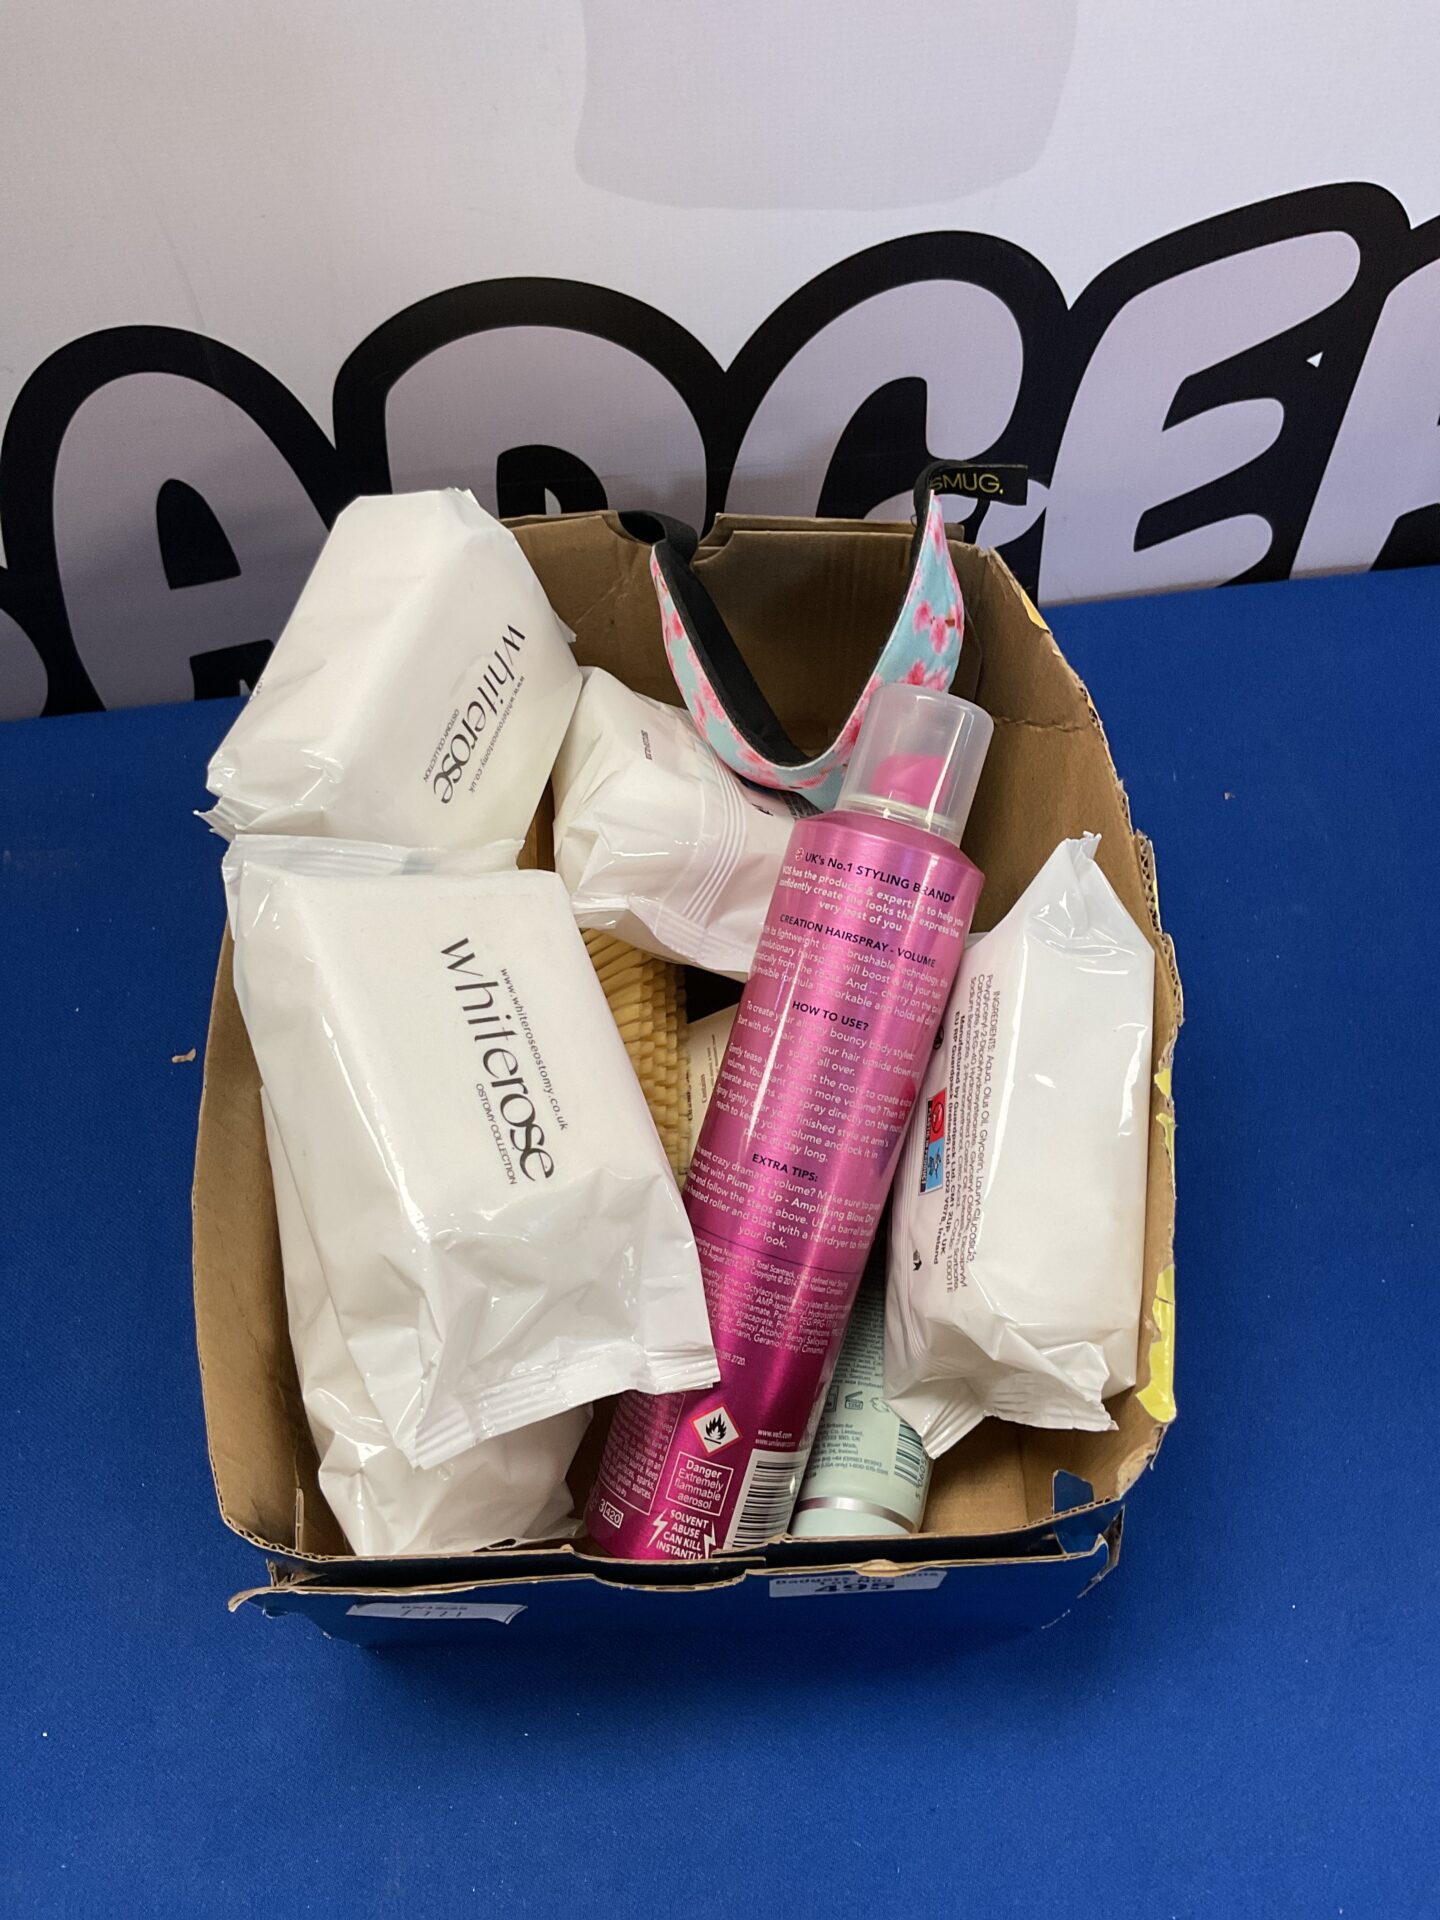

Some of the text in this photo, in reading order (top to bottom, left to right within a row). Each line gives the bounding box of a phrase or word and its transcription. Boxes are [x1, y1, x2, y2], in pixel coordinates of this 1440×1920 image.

[930, 473, 1004, 494] SMUG.
[433, 624, 526, 804] whiterose
[423, 708, 460, 782] OSTOMY COLLECTION
[469, 676, 525, 793] www.whiteroseostomy.co.uk
[805, 852, 825, 865] UK's
[827, 857, 852, 872] No.1
[856, 865, 909, 889] STYLING
[804, 870, 953, 923] the to help
[813, 887, 842, 899] create
[866, 899, 894, 915] looks
[919, 918, 948, 934] express
[819, 901, 881, 925] very of
[777, 928, 892, 968] lightweight brushable
[780, 914, 935, 967] CREATION HAIRSPRAY VOLUME
[777, 956, 795, 969] from
[845, 978, 867, 991] And
[861, 968, 890, 983] boost
[752, 1005, 775, 1017] create
[830, 1028, 866, 1048] bouncy
[868, 1040, 892, 1055] body
[792, 1001, 869, 1030] HOW TO USE?
[893, 1007, 915, 1021] holds
[954, 1011, 960, 1025] EU
[988, 991, 1000, 1049] INGREDIENTS:
[441, 938, 554, 1182] whiterose
[501, 968, 569, 1131] www.whiteroseostomy.co.uk
[748, 1019, 761, 1030] with
[762, 1024, 775, 1036] dry
[841, 1049, 860, 1062] hair
[862, 1057, 891, 1072] upside
[955, 1015, 965, 1083] Manufactured
[744, 1050, 762, 1063] tease
[819, 1075, 834, 1087] the
[865, 1090, 876, 1099] to
[876, 1093, 899, 1105] create
[749, 1065, 762, 1078] You
[815, 1090, 840, 1103] more
[817, 1057, 855, 1076] all over.
[984, 1055, 993, 1083] Aqua,
[952, 1087, 960, 1098] by
[982, 1086, 991, 1108] Olus
[475, 1083, 517, 1185] OSTOMY COLLECTION
[728, 1089, 749, 1106] lightly
[870, 1137, 889, 1148] arm's
[730, 1106, 738, 1116] to
[824, 1139, 841, 1150] and
[864, 1119, 876, 1127] on
[877, 1120, 888, 1130] the
[752, 1153, 818, 1182] EXTRA TIPS:
[783, 1139, 829, 1163] day long.
[976, 1129, 987, 1173] Glycerin,
[710, 1168, 725, 1180] with
[726, 1175, 754, 1193] Plump
[768, 1190, 783, 1203] Up
[846, 1211, 864, 1223] Blow
[864, 1214, 875, 1226] Dry
[712, 1154, 730, 1169] crazy
[844, 1198, 860, 1208] sure
[974, 1176, 983, 1205] Lauryl
[706, 1180, 728, 1196] follow
[729, 1191, 744, 1203] the
[776, 1209, 808, 1224] above.
[837, 1223, 859, 1235] barrel
[708, 1198, 729, 1212] roller
[731, 1208, 750, 1220] and
[751, 1213, 776, 1229] blast
[778, 1224, 800, 1237] with
[802, 1232, 808, 1240] a
[737, 1226, 787, 1248] your look.
[933, 1227, 943, 1264] Ireland
[940, 1238, 947, 1255] UK
[678, 1468, 723, 1492] Extremely
[686, 1459, 722, 1482] Danger
[675, 1477, 720, 1501] flammable
[678, 1493, 712, 1511] aerosol
[598, 1498, 623, 1523] 3 420
[671, 1510, 708, 1528] SOLVENT
[663, 1531, 701, 1551] CAN KILL
[672, 1522, 700, 1538] ABUSE
[657, 1541, 702, 1562] INSTANTLY
